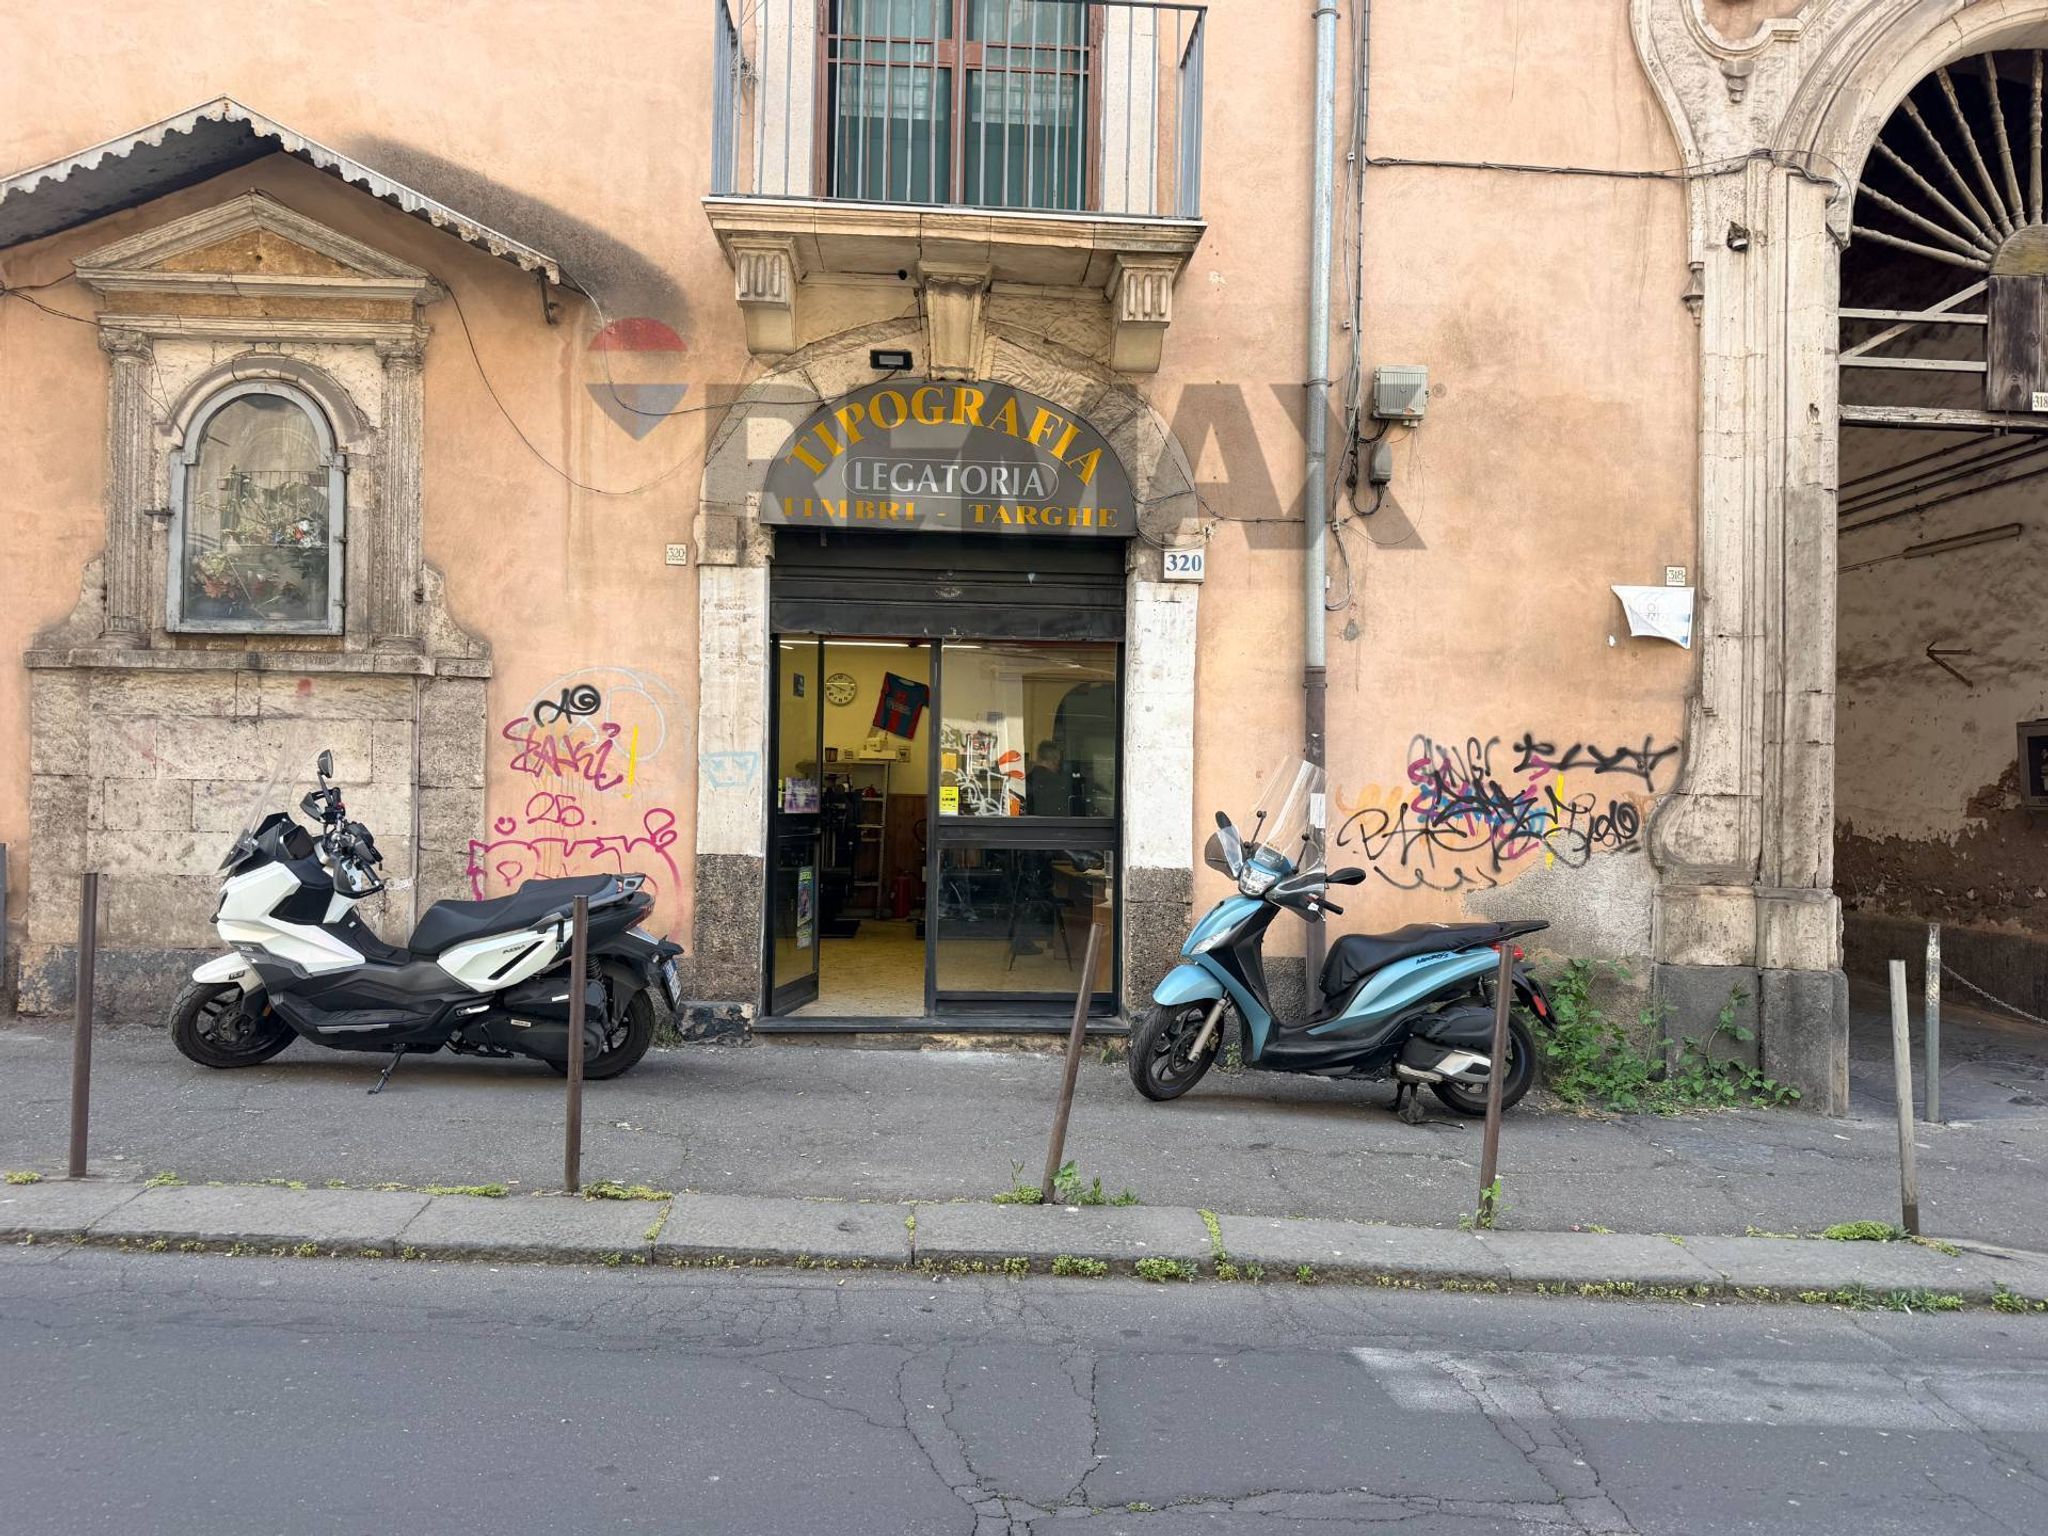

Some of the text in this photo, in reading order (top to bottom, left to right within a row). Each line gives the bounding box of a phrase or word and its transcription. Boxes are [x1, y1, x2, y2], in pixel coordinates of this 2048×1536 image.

[785, 386, 1103, 486] TIPOGRAFIA
[854, 461, 1045, 497] LEGATORIA
[968, 504, 1120, 528] TARGHE
[1166, 554, 1202, 571] 320
